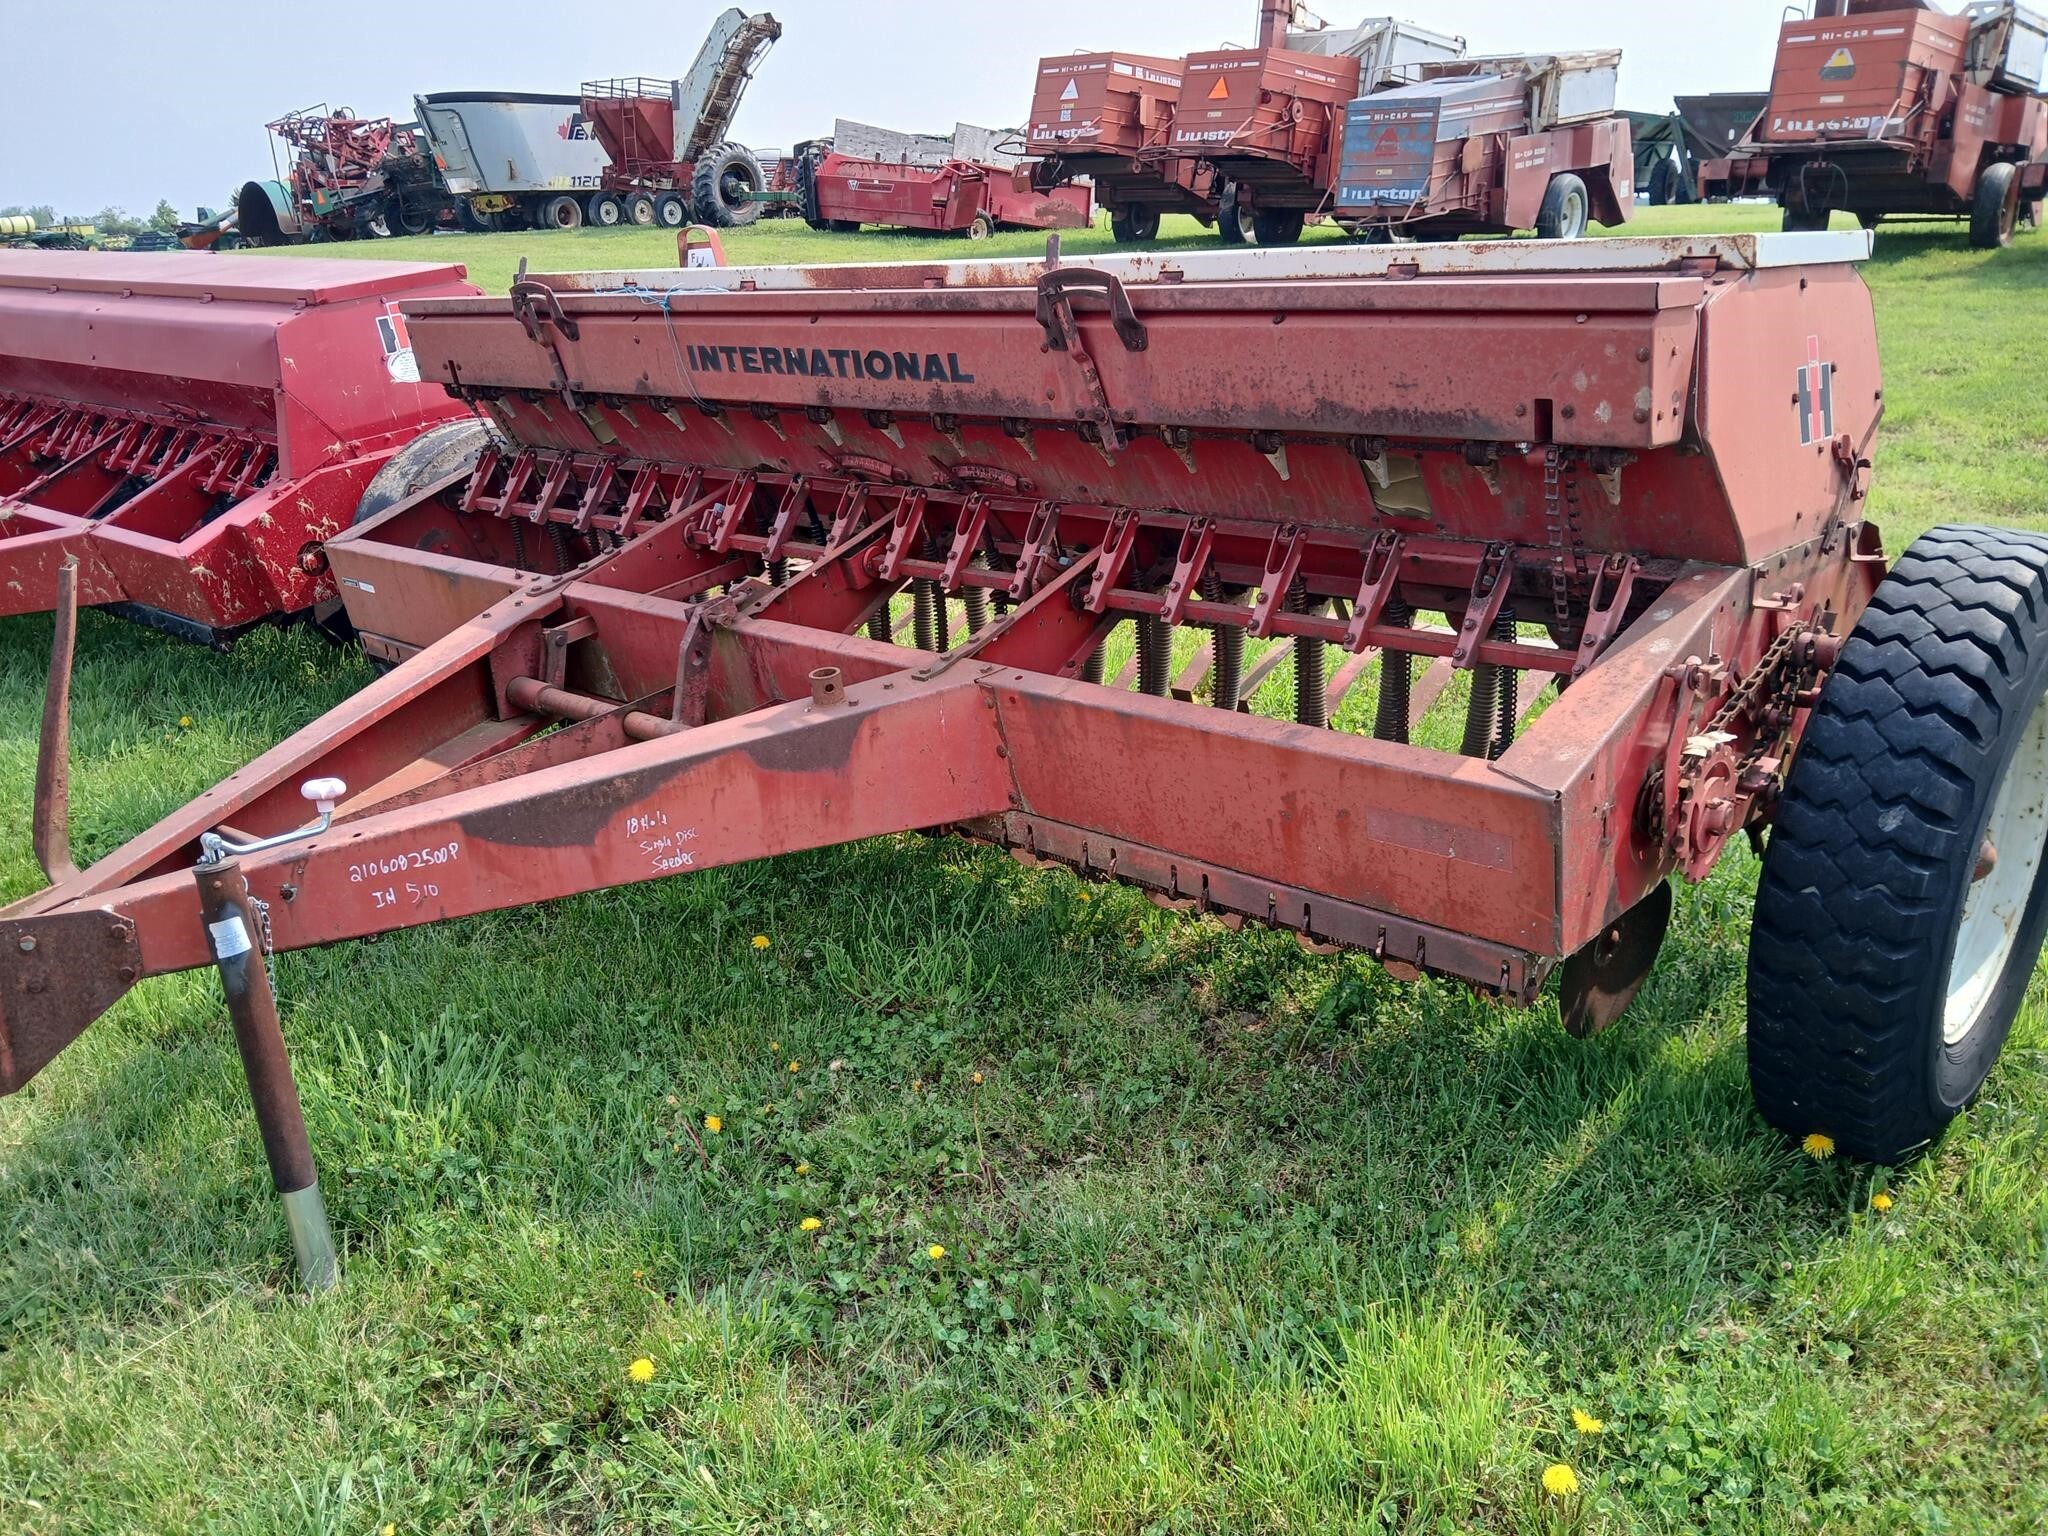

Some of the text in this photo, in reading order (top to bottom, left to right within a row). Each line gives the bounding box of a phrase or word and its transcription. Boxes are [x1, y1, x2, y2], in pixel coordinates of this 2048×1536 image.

[1822, 30, 1868, 40] HI-CAP
[1374, 112, 1409, 121] HI-CAP
[686, 344, 975, 384] INTERNATIONAL
[405, 882, 439, 903] 510
